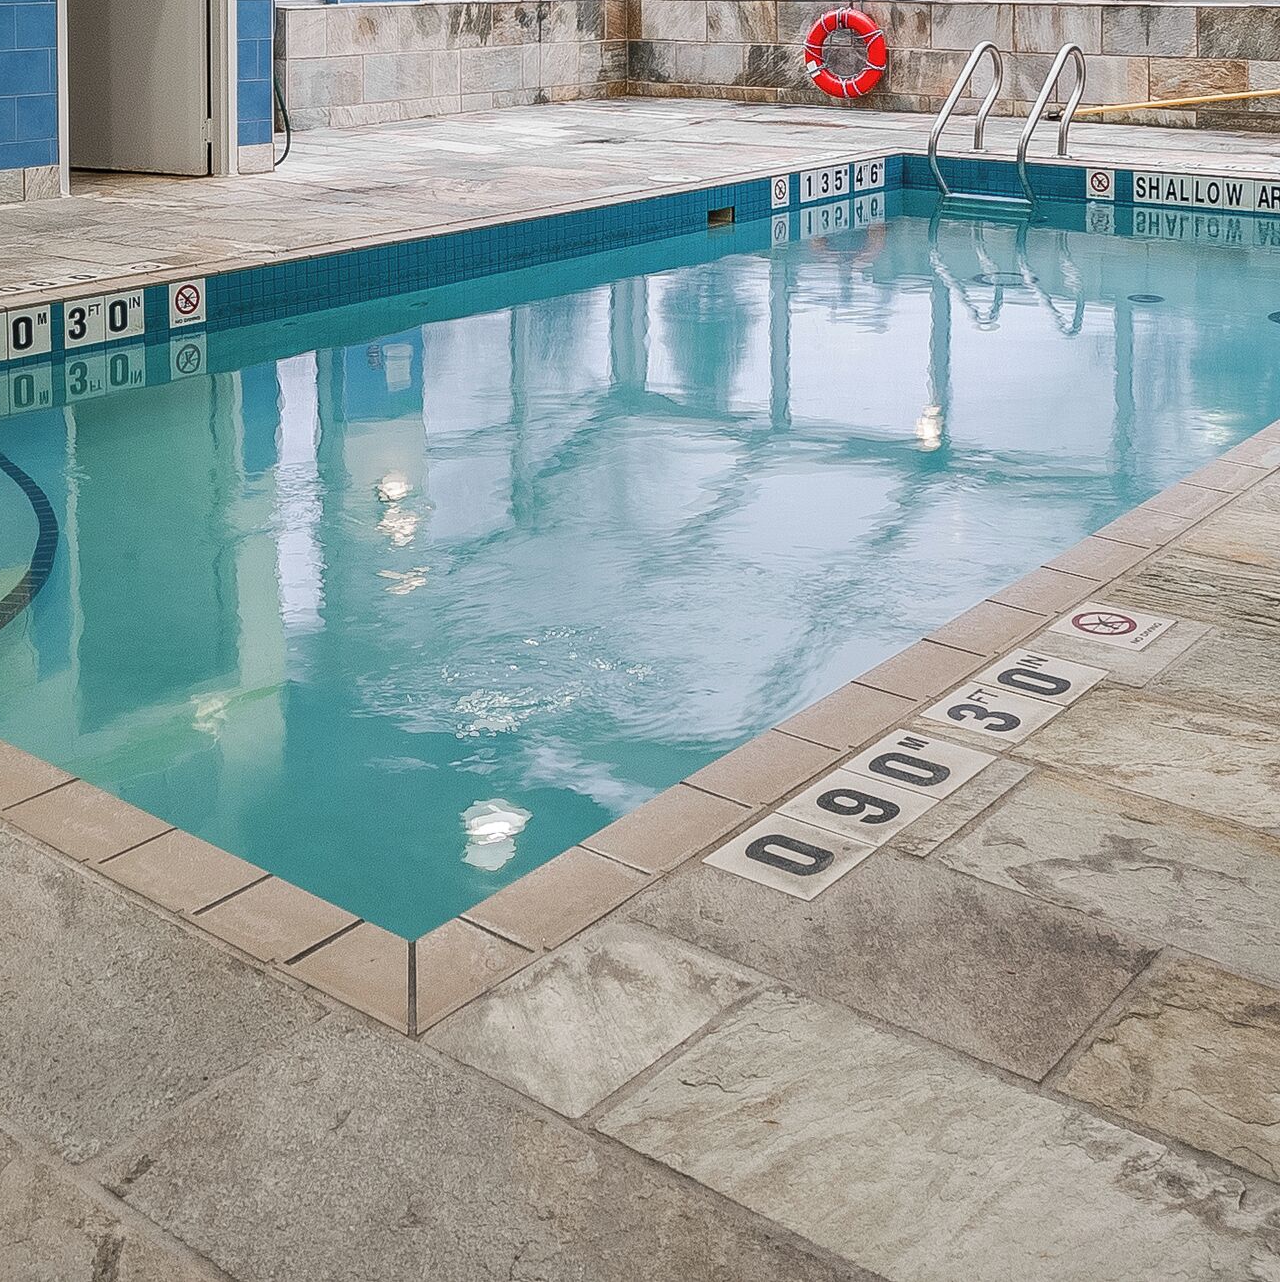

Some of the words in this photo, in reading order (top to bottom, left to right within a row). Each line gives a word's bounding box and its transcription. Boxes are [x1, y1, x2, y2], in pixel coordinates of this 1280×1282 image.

[856, 165, 864, 187] 4
[870, 163, 878, 184] 6
[1135, 176, 1243, 206] SHALLOW
[68, 306, 87, 341] 3
[87, 302, 102, 317] FT
[108, 298, 128, 333] 0
[128, 295, 141, 310] IN
[1016, 653, 1049, 670] IN
[996, 668, 1071, 697] 0
[946, 703, 1021, 733] 3
